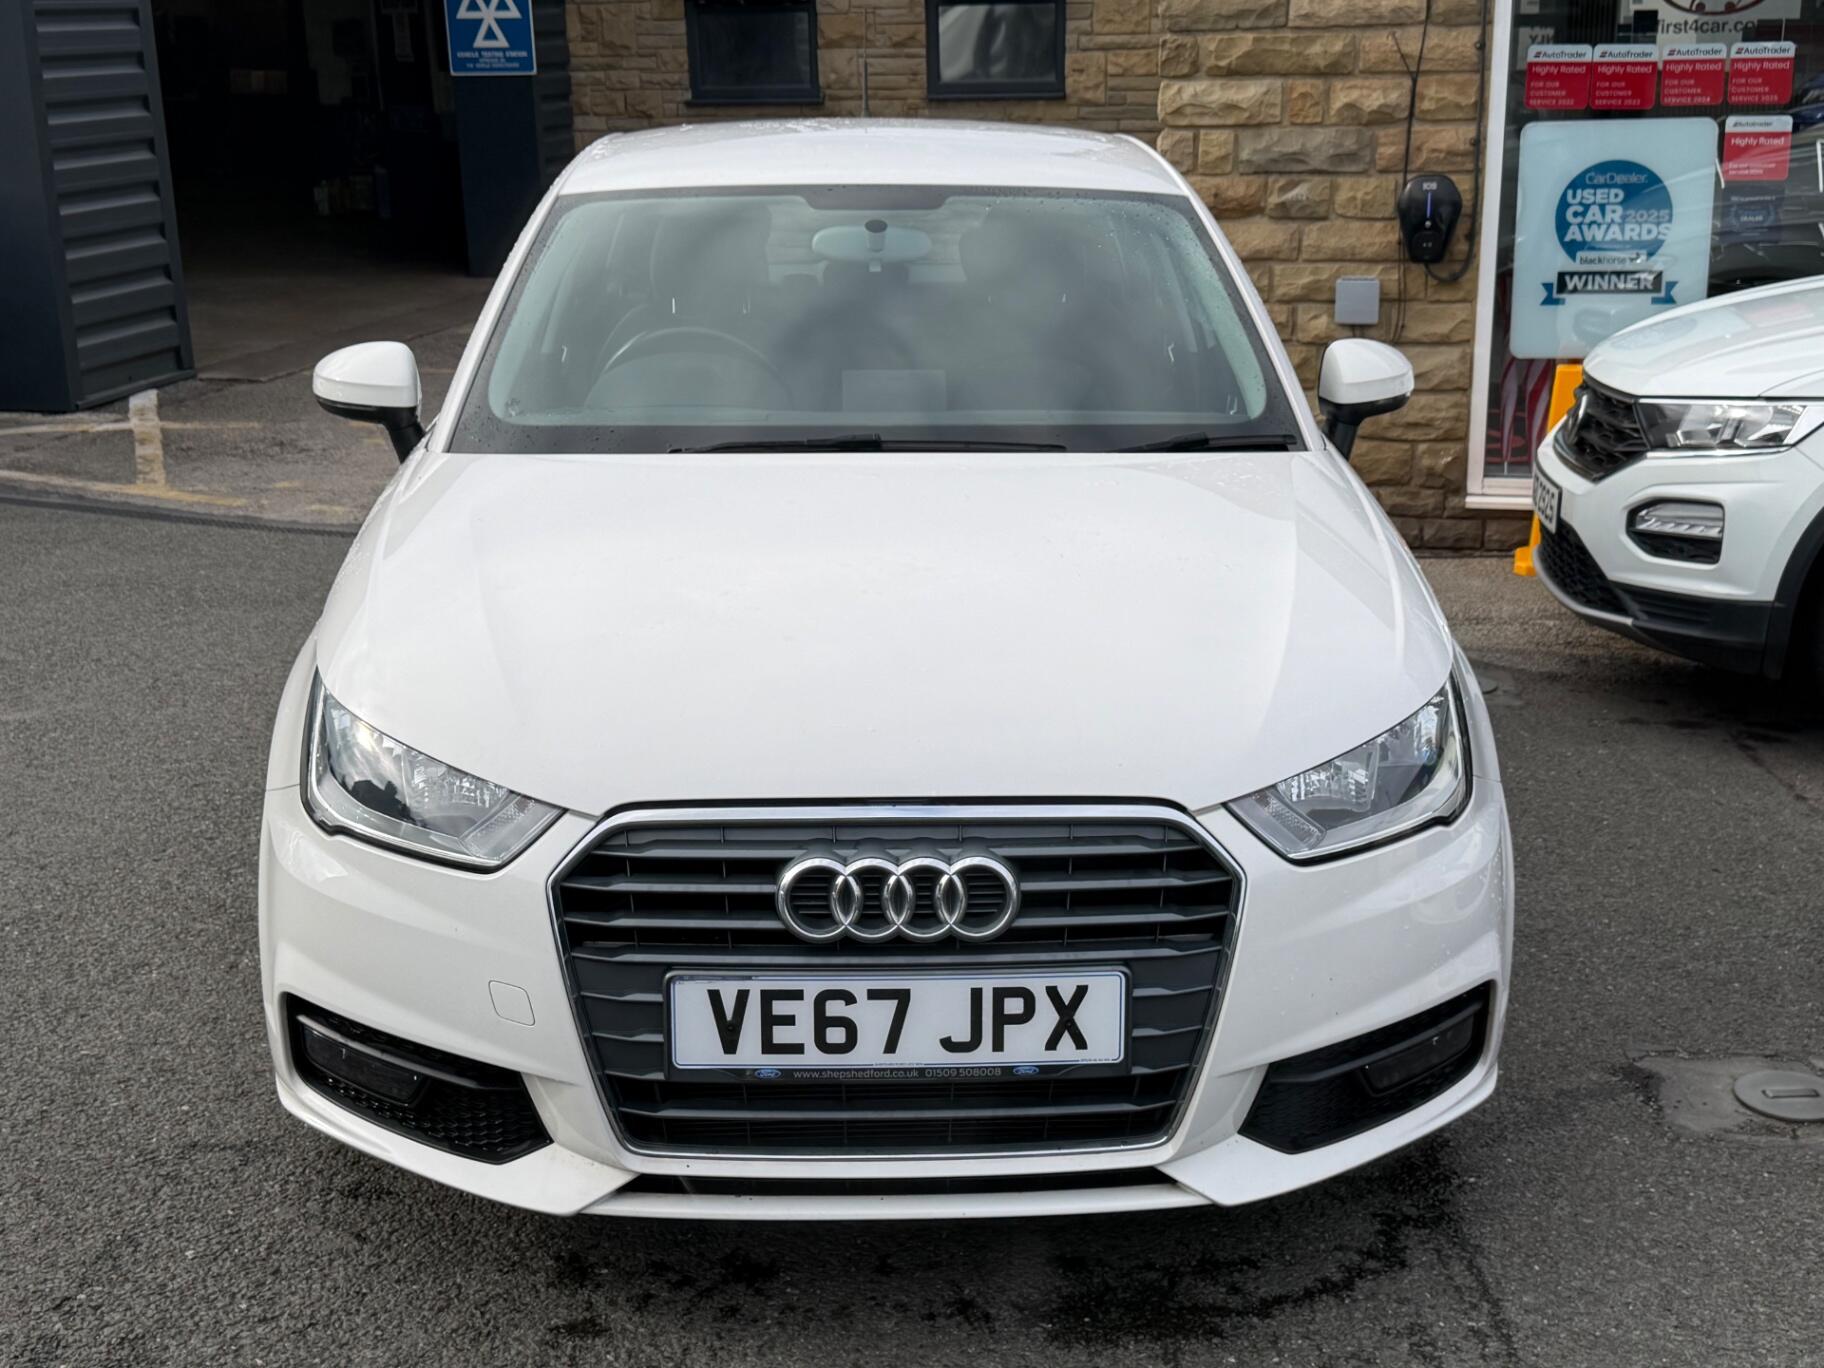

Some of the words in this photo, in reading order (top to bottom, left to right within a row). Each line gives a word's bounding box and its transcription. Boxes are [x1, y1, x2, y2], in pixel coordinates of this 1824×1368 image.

[1541, 51, 1587, 59] AutoTrader
[1607, 51, 1653, 59] AutoTrader
[1676, 48, 1723, 56] AutoTrader
[1744, 47, 1791, 55] AutoTrader
[1532, 65, 1559, 76] Highly
[1560, 65, 1586, 74] Rated
[1598, 65, 1625, 76] Highly
[1626, 65, 1652, 74] Rated
[1665, 62, 1693, 73] Highly
[1695, 62, 1722, 71] Rated
[1734, 61, 1761, 72] Highly
[1762, 60, 1790, 70] Rated
[1731, 137, 1758, 147] Highly
[1759, 136, 1785, 145] Rated
[1566, 188, 1624, 204] USED
[1565, 205, 1623, 224] CAR
[1625, 209, 1670, 222] 2025
[1564, 223, 1673, 242] AWARDS
[1579, 254, 1626, 265] blackhorse
[1565, 274, 1653, 291] WINNER
[707, 987, 911, 1056] VE67
[938, 984, 1089, 1054] JPX
[793, 1068, 919, 1080] www.shepshedford.co.uk
[925, 1068, 957, 1077] 01509
[959, 1067, 1002, 1077] 508008
